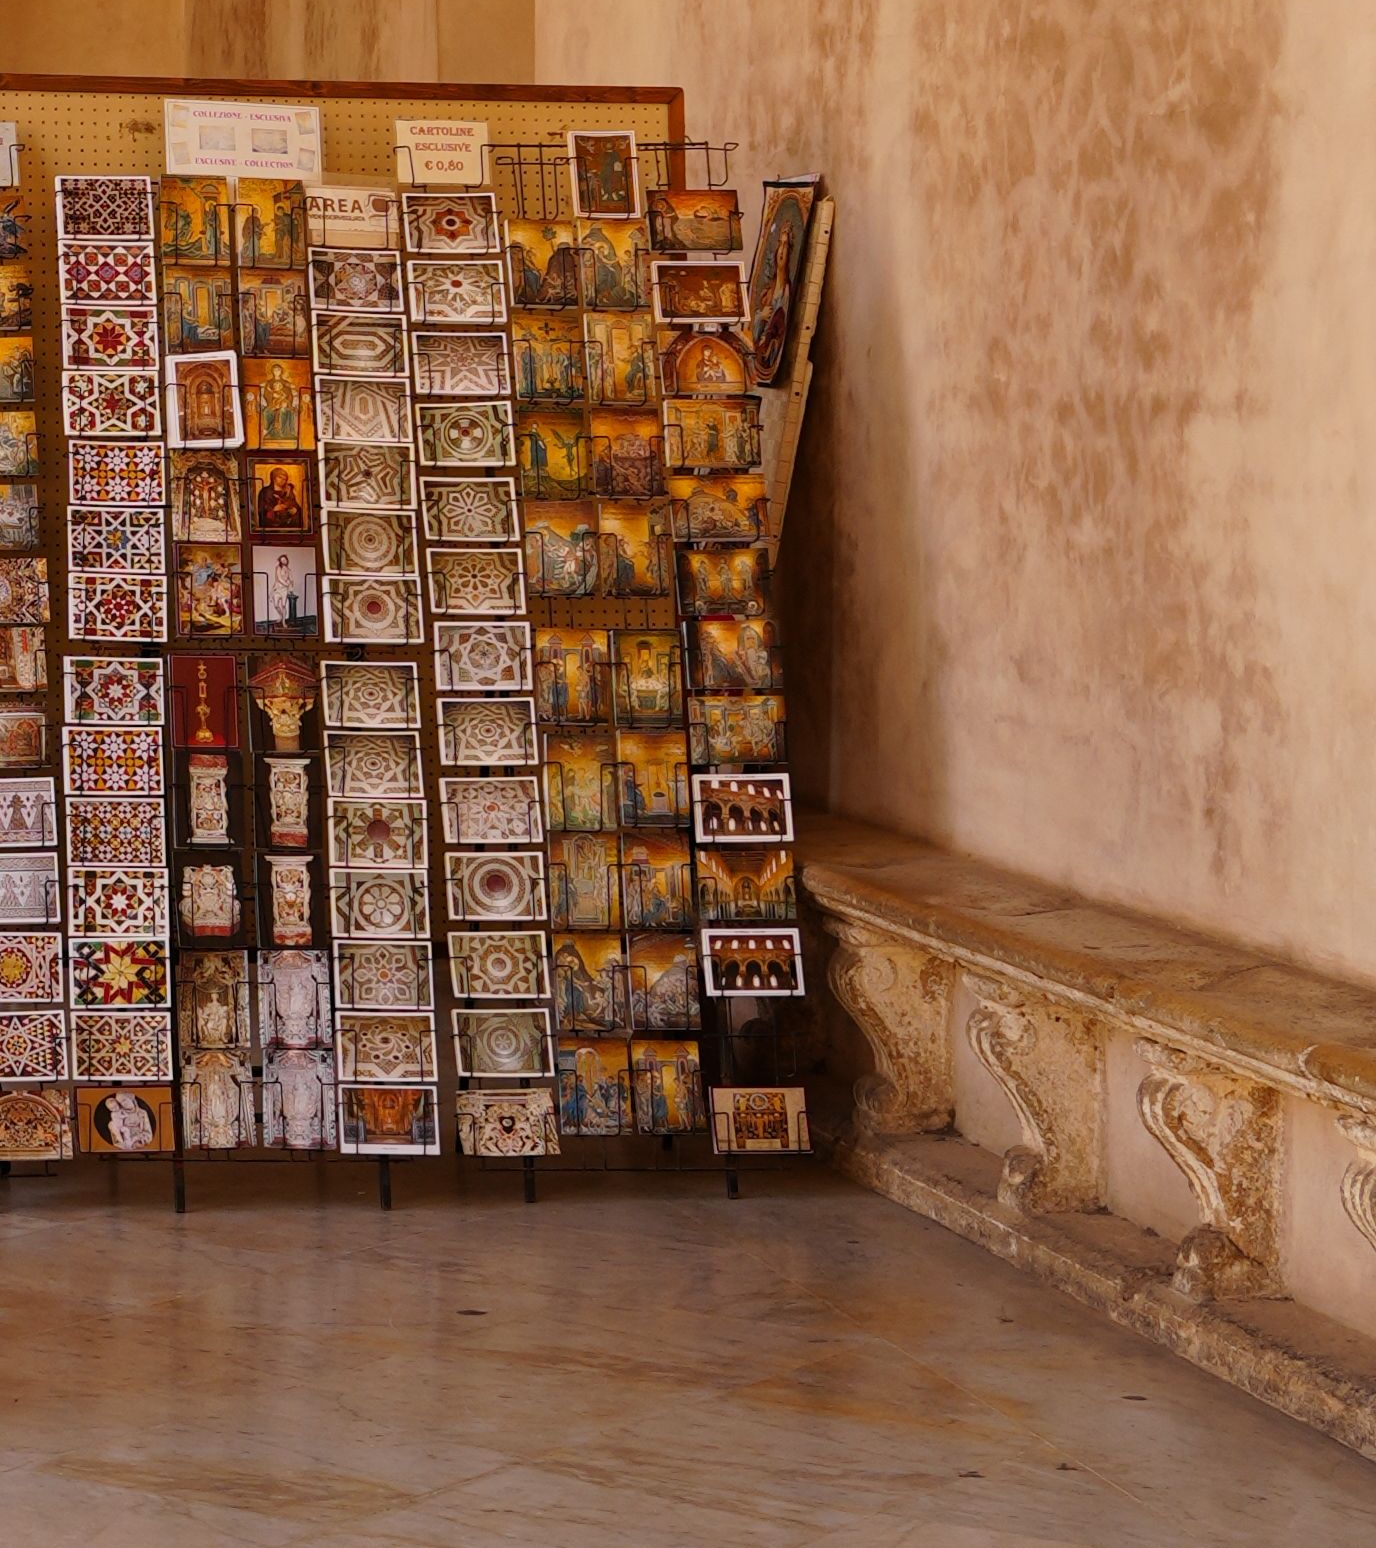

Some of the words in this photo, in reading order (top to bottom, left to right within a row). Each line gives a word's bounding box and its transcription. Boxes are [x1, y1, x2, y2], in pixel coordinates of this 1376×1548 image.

[192, 110, 241, 120] COLLEZIONE
[249, 114, 292, 123] ESCLUSIVA
[410, 126, 475, 137] CARTOLINE
[415, 142, 472, 153] ESCLUSIVE
[195, 157, 236, 166] EXCLUSIVE
[244, 159, 294, 169] COLLECTION
[423, 160, 434, 171] €
[436, 159, 464, 172] 0,80
[308, 196, 364, 213] AREA
